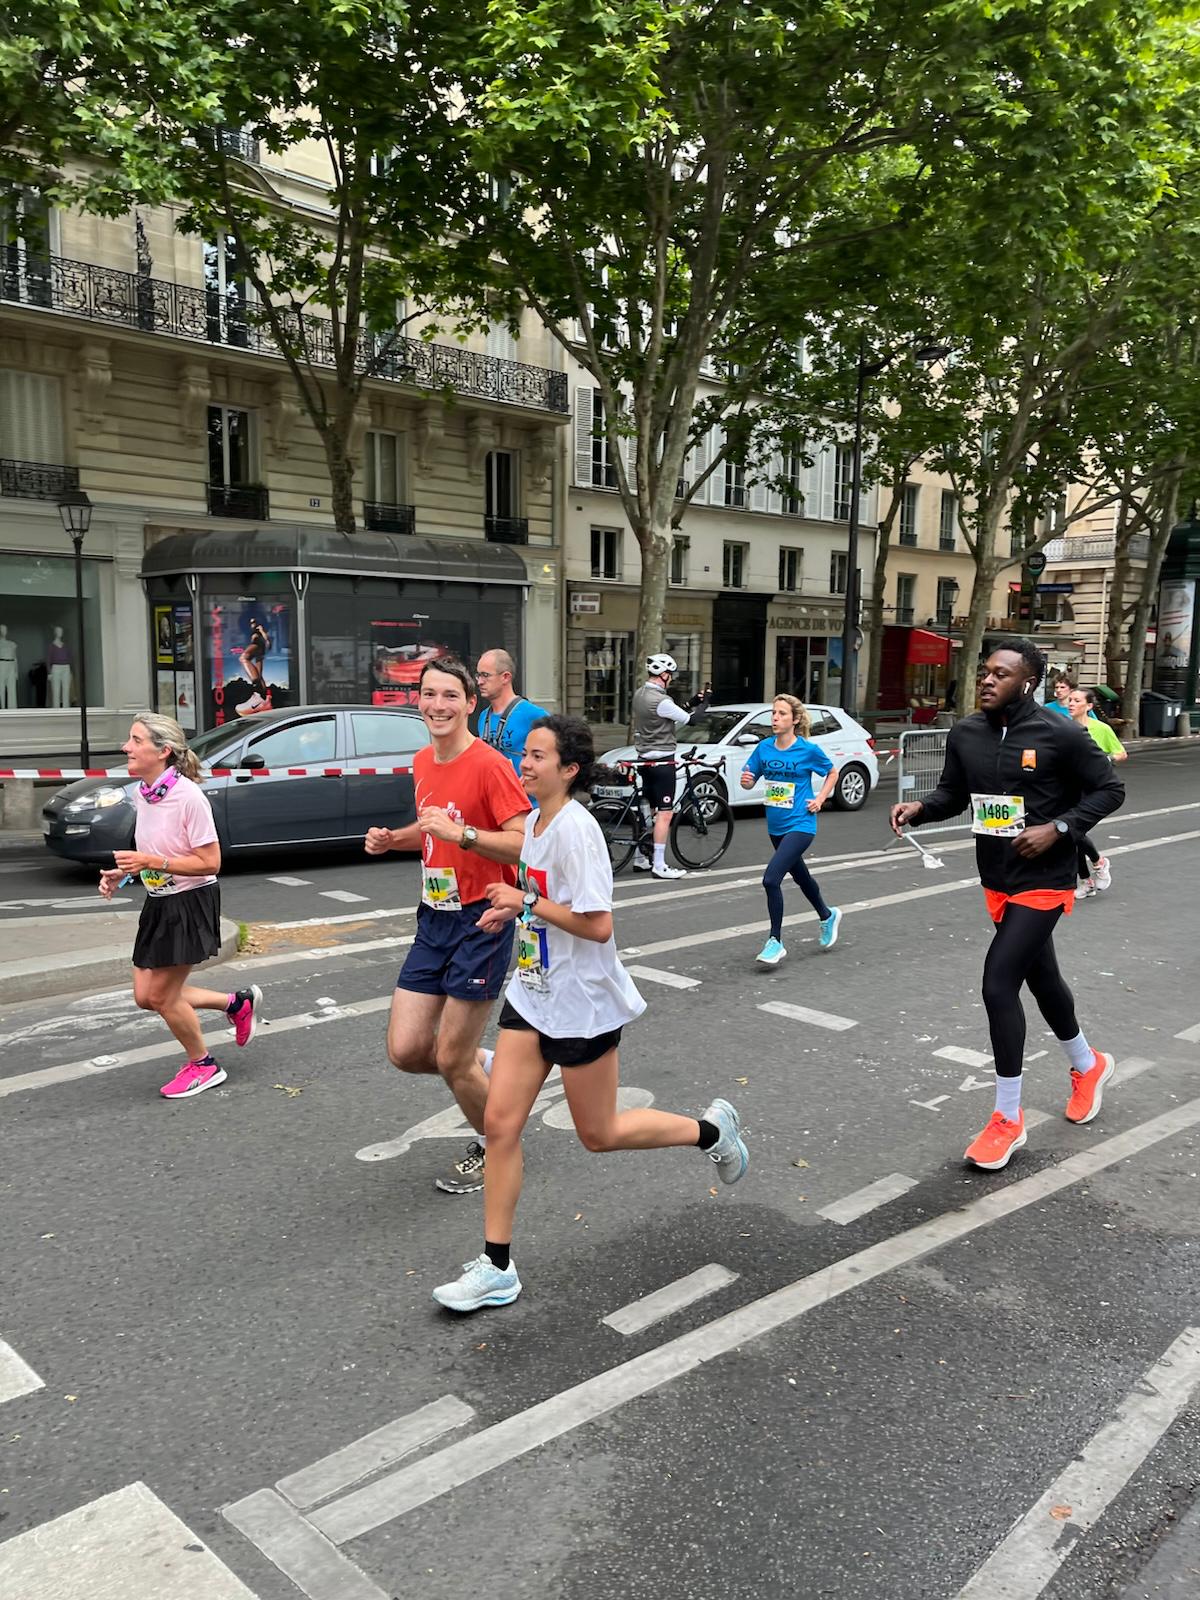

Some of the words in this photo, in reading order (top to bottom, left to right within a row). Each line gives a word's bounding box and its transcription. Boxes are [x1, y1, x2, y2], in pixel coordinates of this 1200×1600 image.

[768, 615, 811, 630] AGENCE
[812, 618, 826, 631] DE
[982, 802, 1009, 820] 1486
